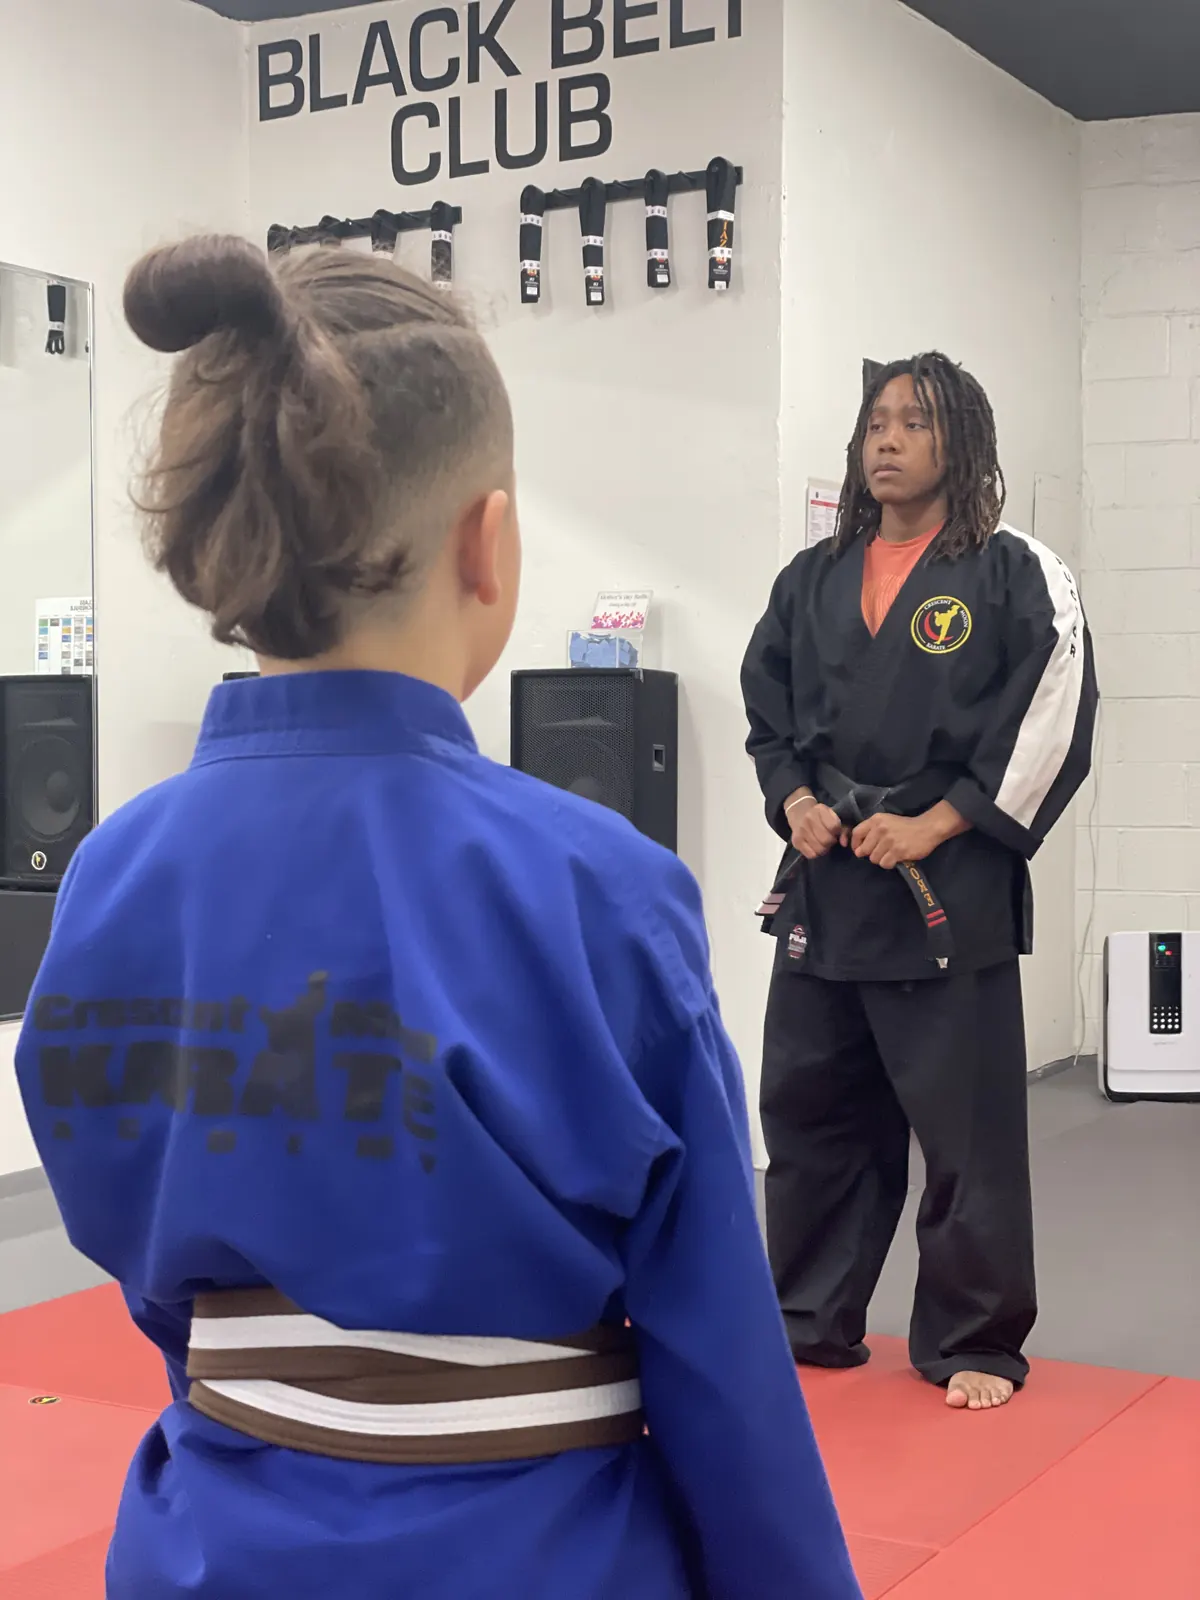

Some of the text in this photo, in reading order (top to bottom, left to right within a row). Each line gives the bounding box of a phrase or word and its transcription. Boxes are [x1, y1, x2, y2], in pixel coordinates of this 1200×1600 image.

[258, 0, 521, 122] BLACK
[391, 72, 612, 186] CLUB
[924, 599, 952, 610] CRESCENT
[926, 642, 946, 650] KARATE
